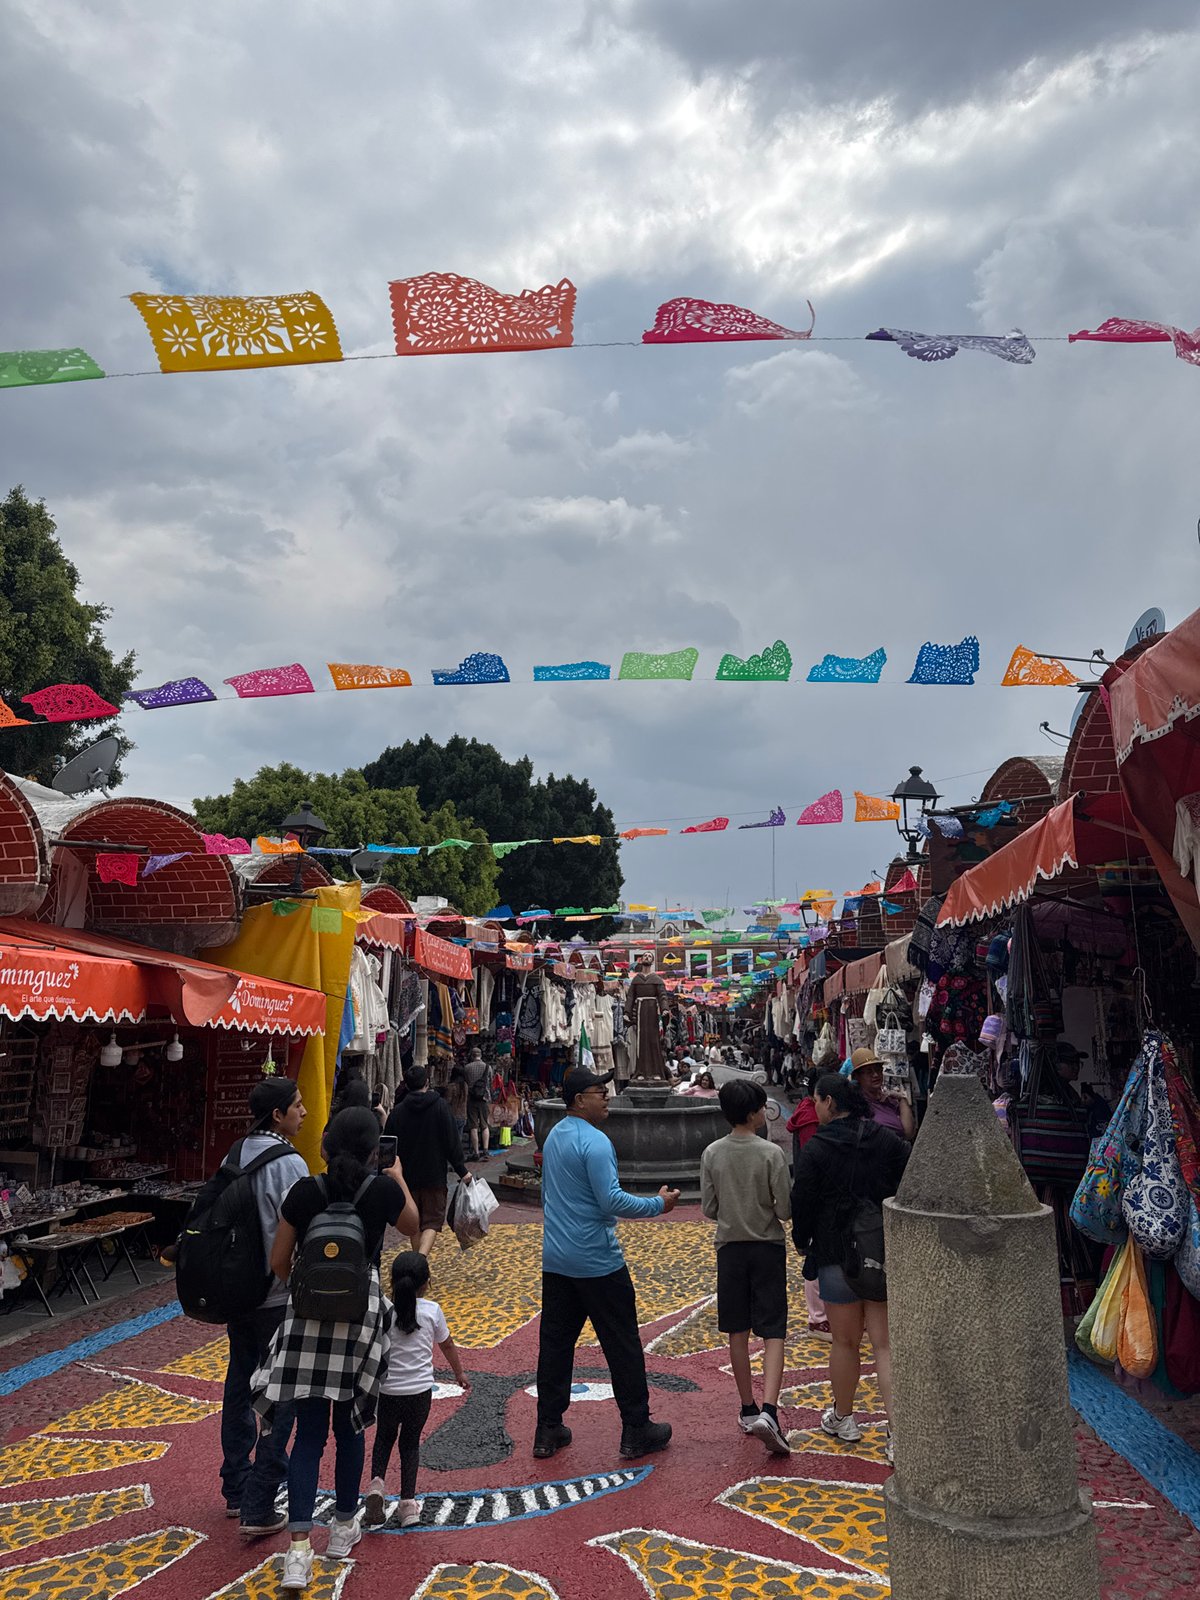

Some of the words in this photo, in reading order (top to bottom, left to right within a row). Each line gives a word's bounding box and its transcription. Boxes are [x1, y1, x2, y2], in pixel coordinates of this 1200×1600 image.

[21, 994, 28, 1003] El
[29, 995, 42, 1003] arte
[43, 996, 55, 1004] que
[241, 989, 290, 1016] Dominguez
